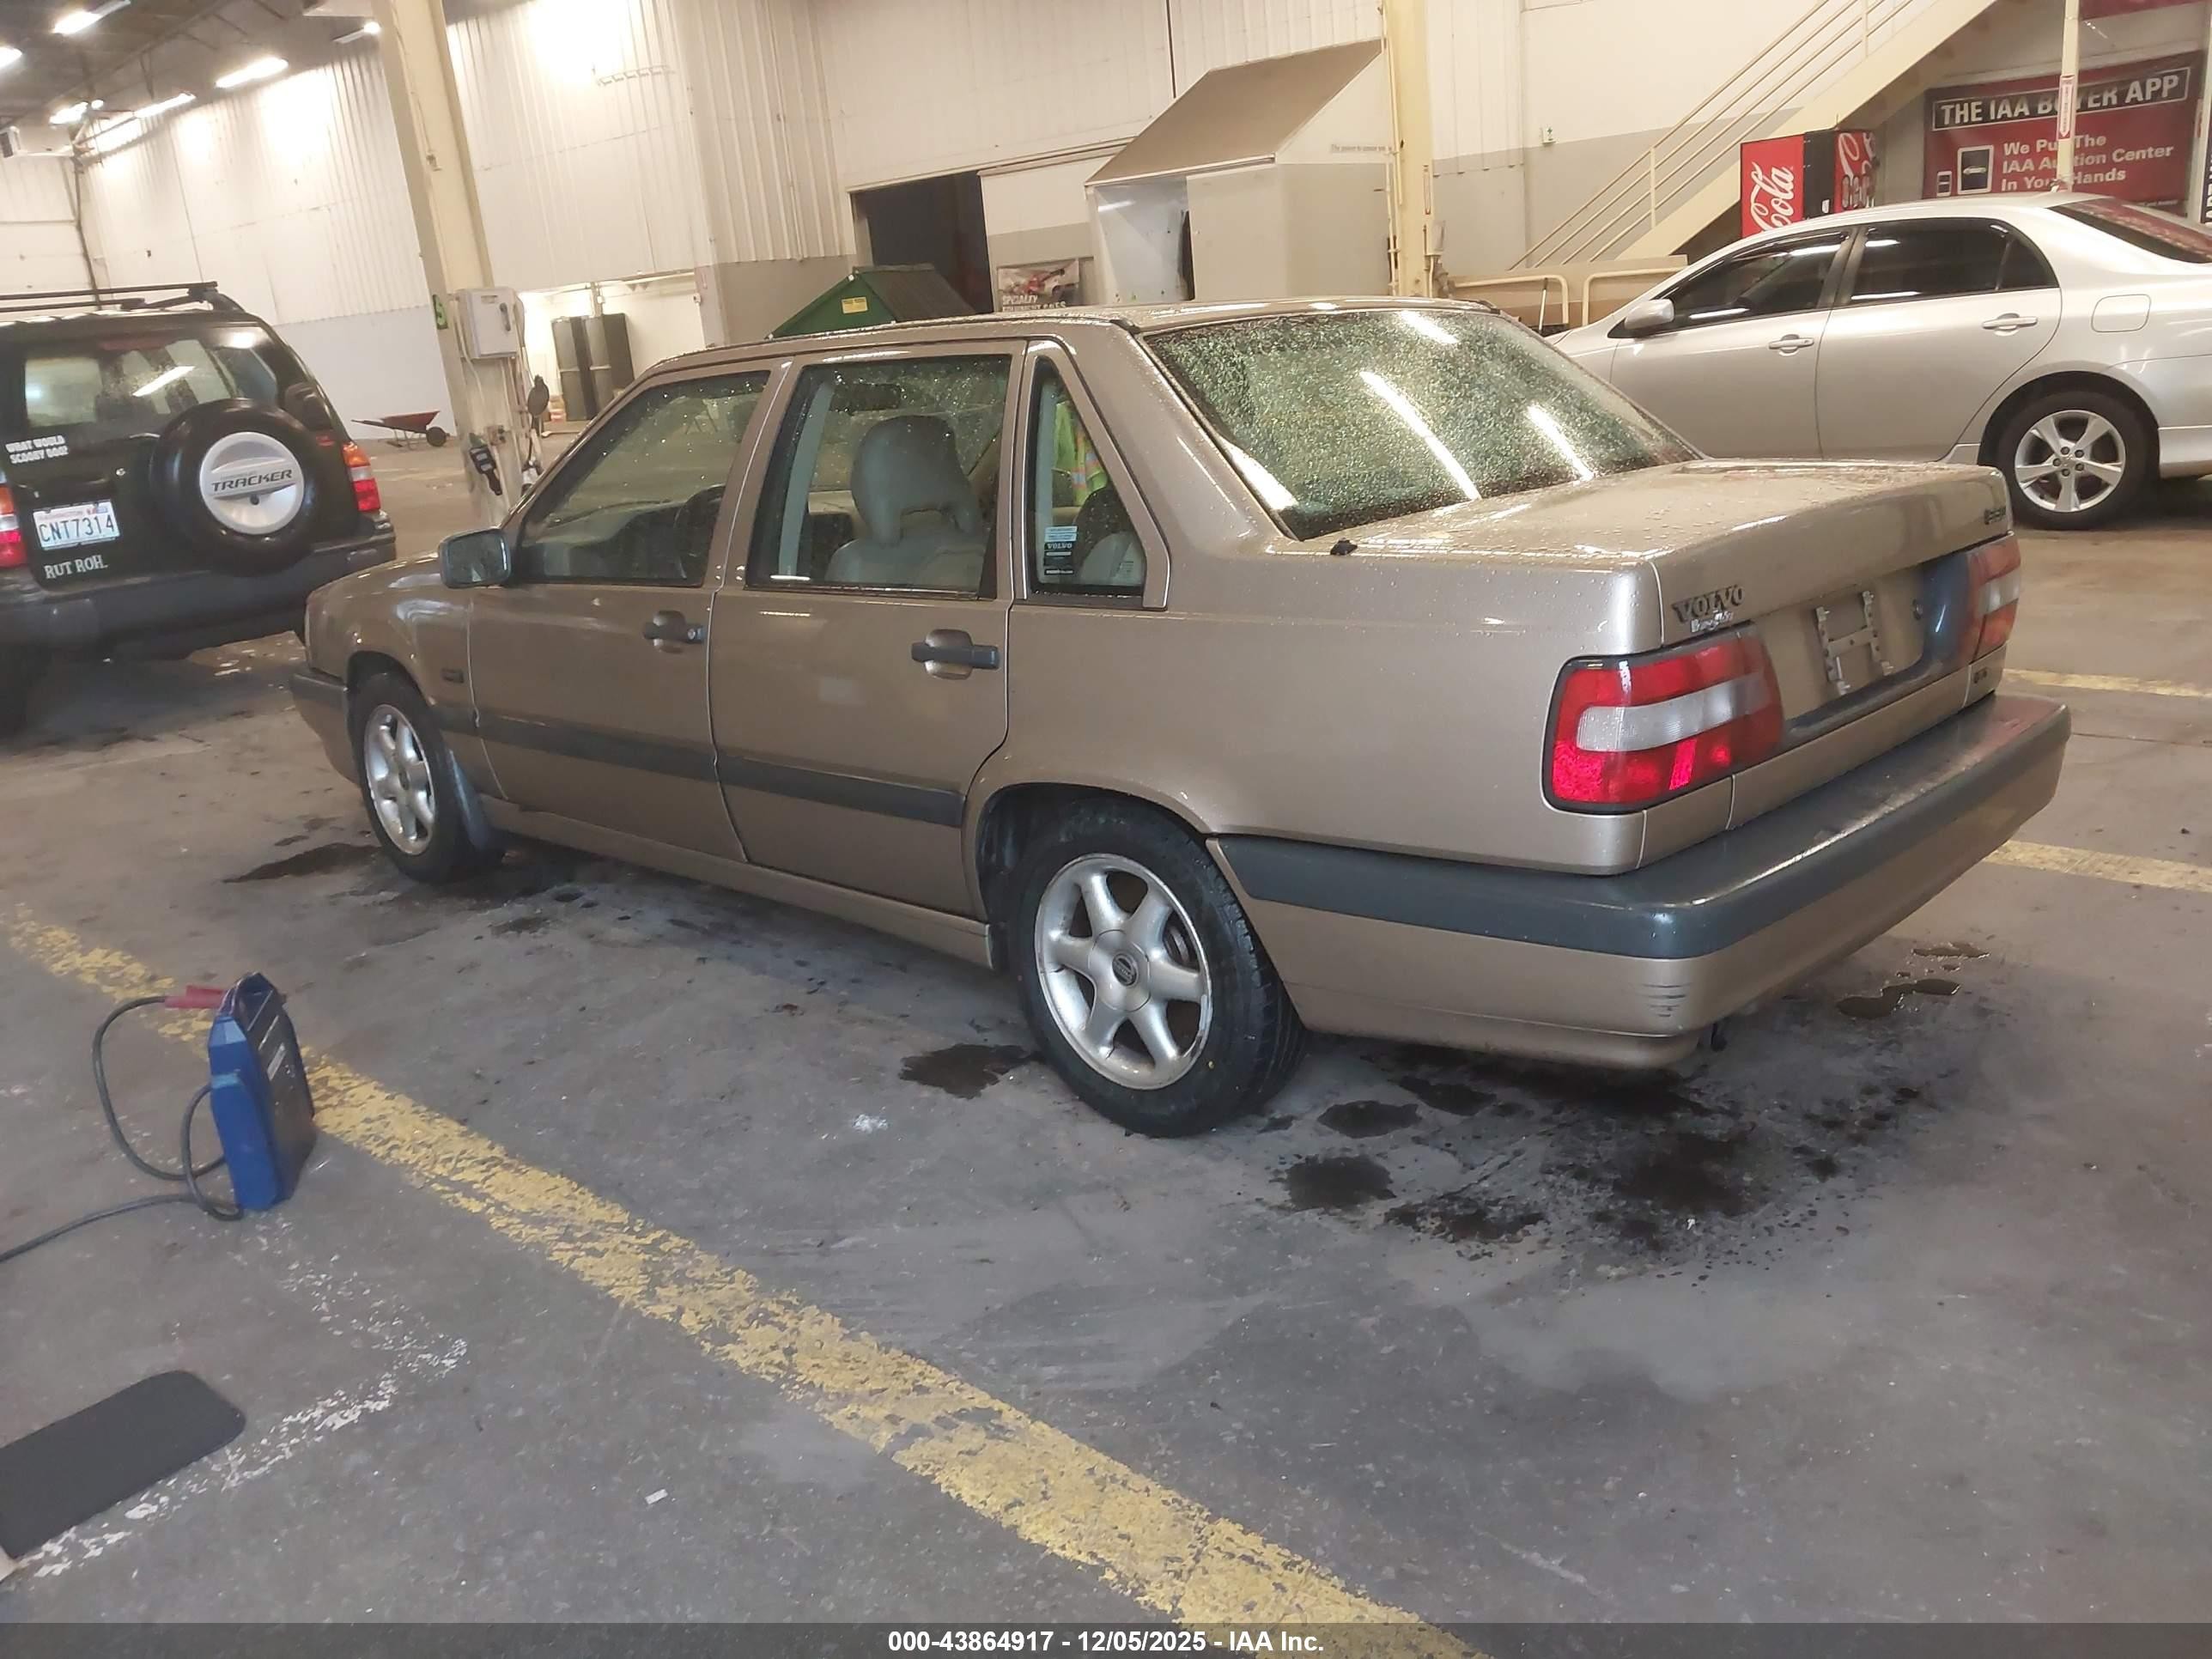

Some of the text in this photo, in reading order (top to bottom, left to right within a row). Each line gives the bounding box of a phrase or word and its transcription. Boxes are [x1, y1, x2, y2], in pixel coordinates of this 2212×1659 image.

[1941, 100, 1984, 125] THE
[1989, 96, 2031, 121] IAA
[2125, 74, 2179, 104] APP
[2003, 141, 2030, 156] We
[2075, 134, 2107, 149] The
[2002, 159, 2036, 174] IAA
[2112, 146, 2174, 163] Center
[2001, 178, 2017, 192] In
[2072, 167, 2126, 185] Hands
[211, 469, 293, 492] TRACKER
[39, 514, 115, 544] CNT7314
[44, 561, 74, 580] RUT
[1671, 584, 1746, 623] VOLVO
